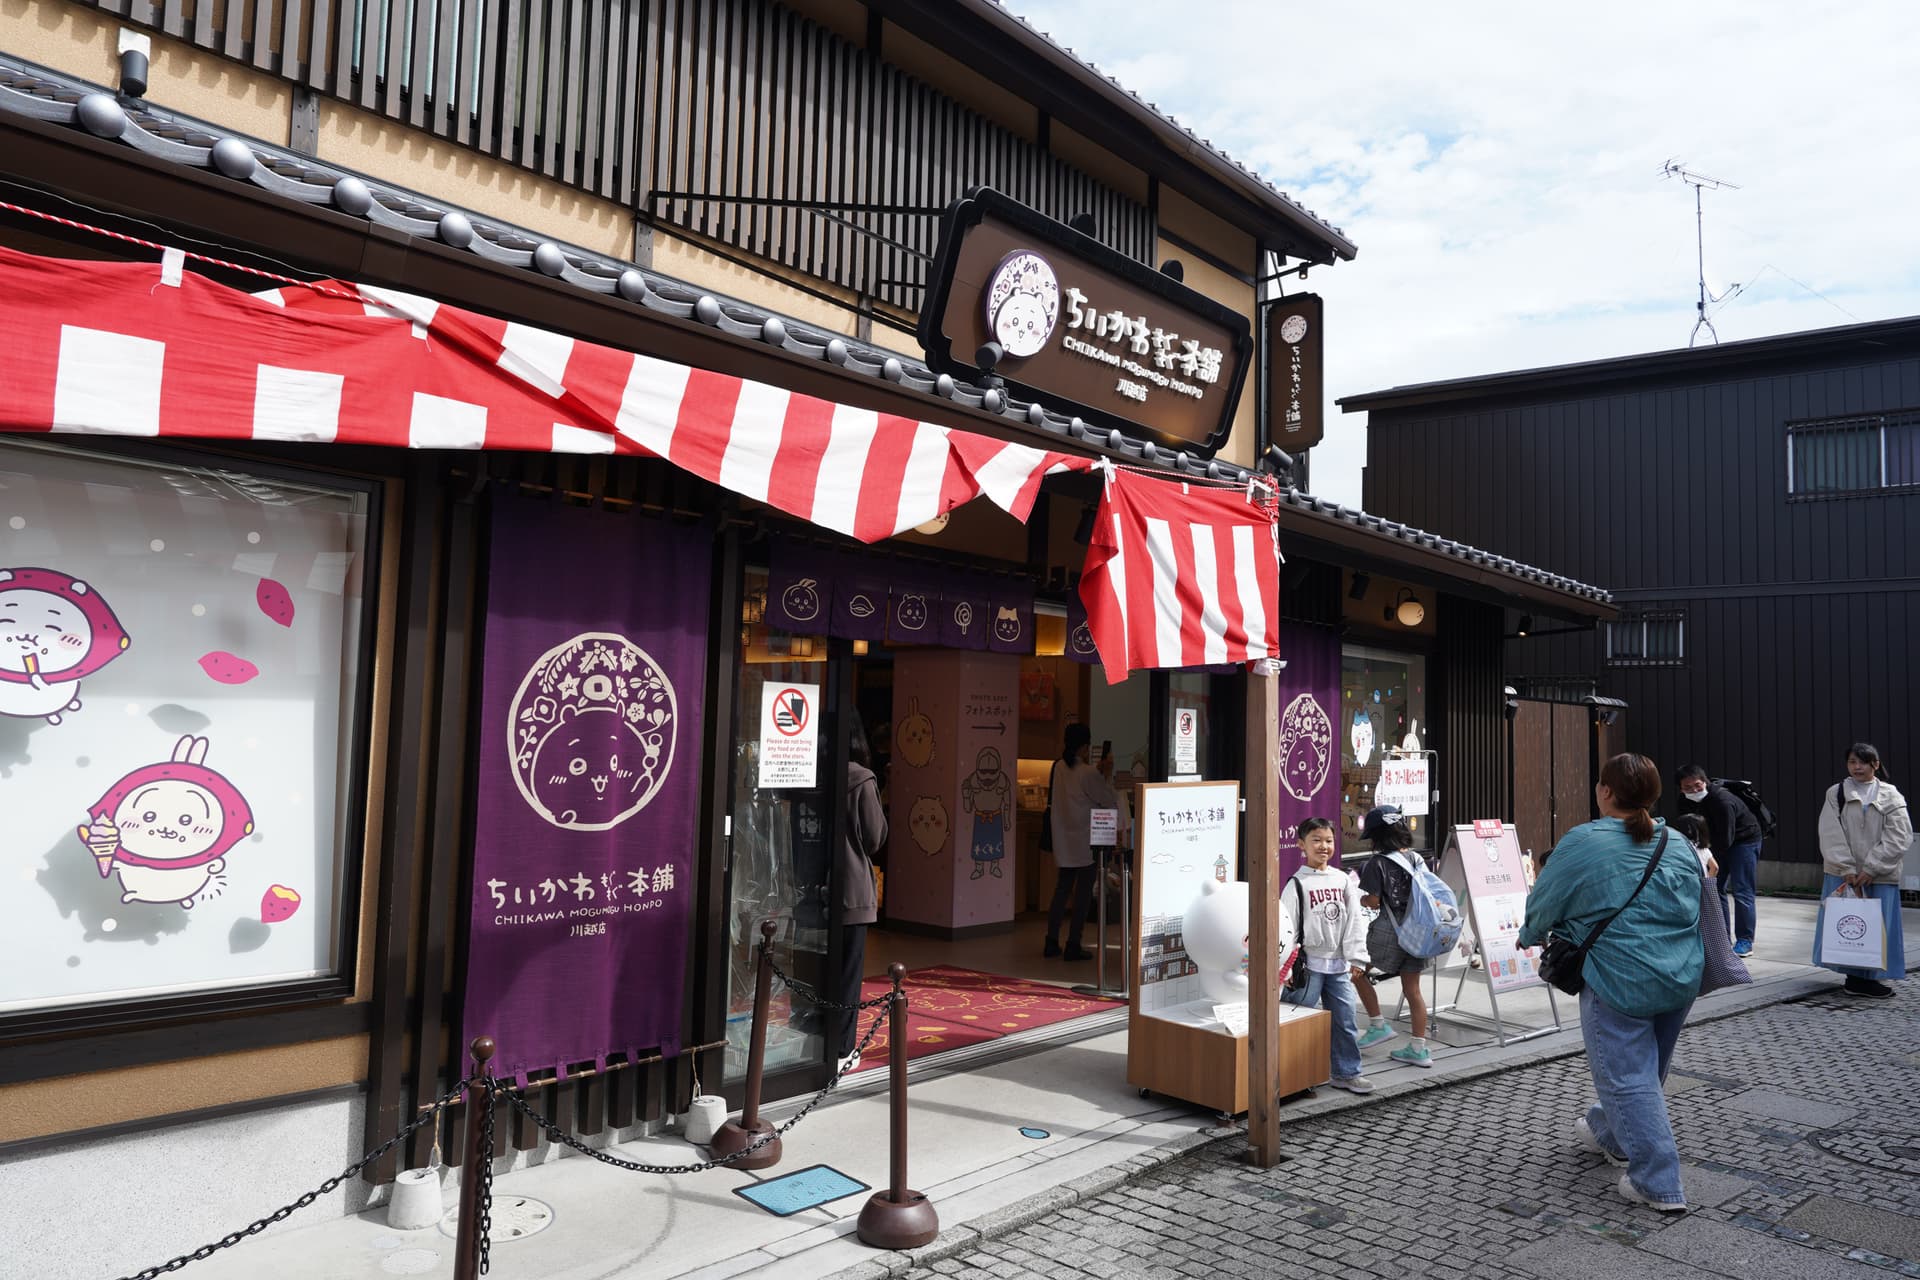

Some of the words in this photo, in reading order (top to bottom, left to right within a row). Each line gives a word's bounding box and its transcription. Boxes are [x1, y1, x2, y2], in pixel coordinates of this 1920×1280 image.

[1063, 336, 1121, 367] CHIIKAWA
[1121, 359, 1169, 387] MOGUMOGU
[1169, 377, 1204, 399] HONPO
[1115, 378, 1149, 402] 川越店
[1309, 888, 1345, 909] AUSTI
[494, 910, 565, 926] CHIIKAWA
[569, 906, 620, 918] MOGUMOGU
[624, 899, 663, 913] HONPO
[570, 922, 607, 937] 川越店
